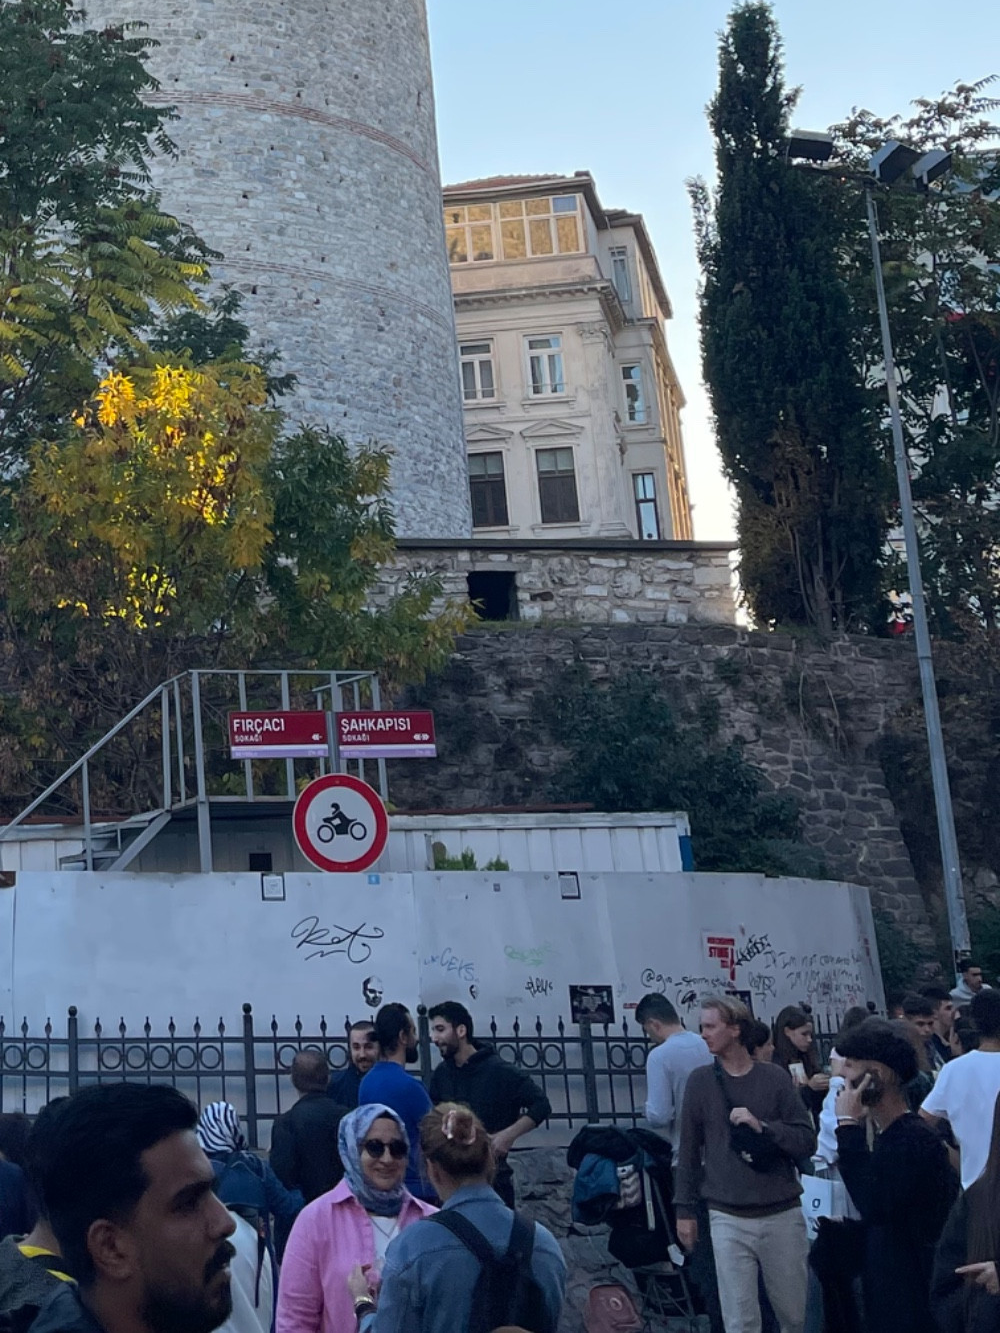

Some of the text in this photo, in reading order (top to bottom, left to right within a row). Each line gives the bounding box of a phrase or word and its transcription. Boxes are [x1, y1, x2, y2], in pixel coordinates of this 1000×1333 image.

[233, 718, 285, 734] FIRÇACI
[341, 717, 411, 733] ŞAHKAPISI
[234, 733, 263, 742] SOKAĞI
[342, 733, 370, 742] SOKAĞI
